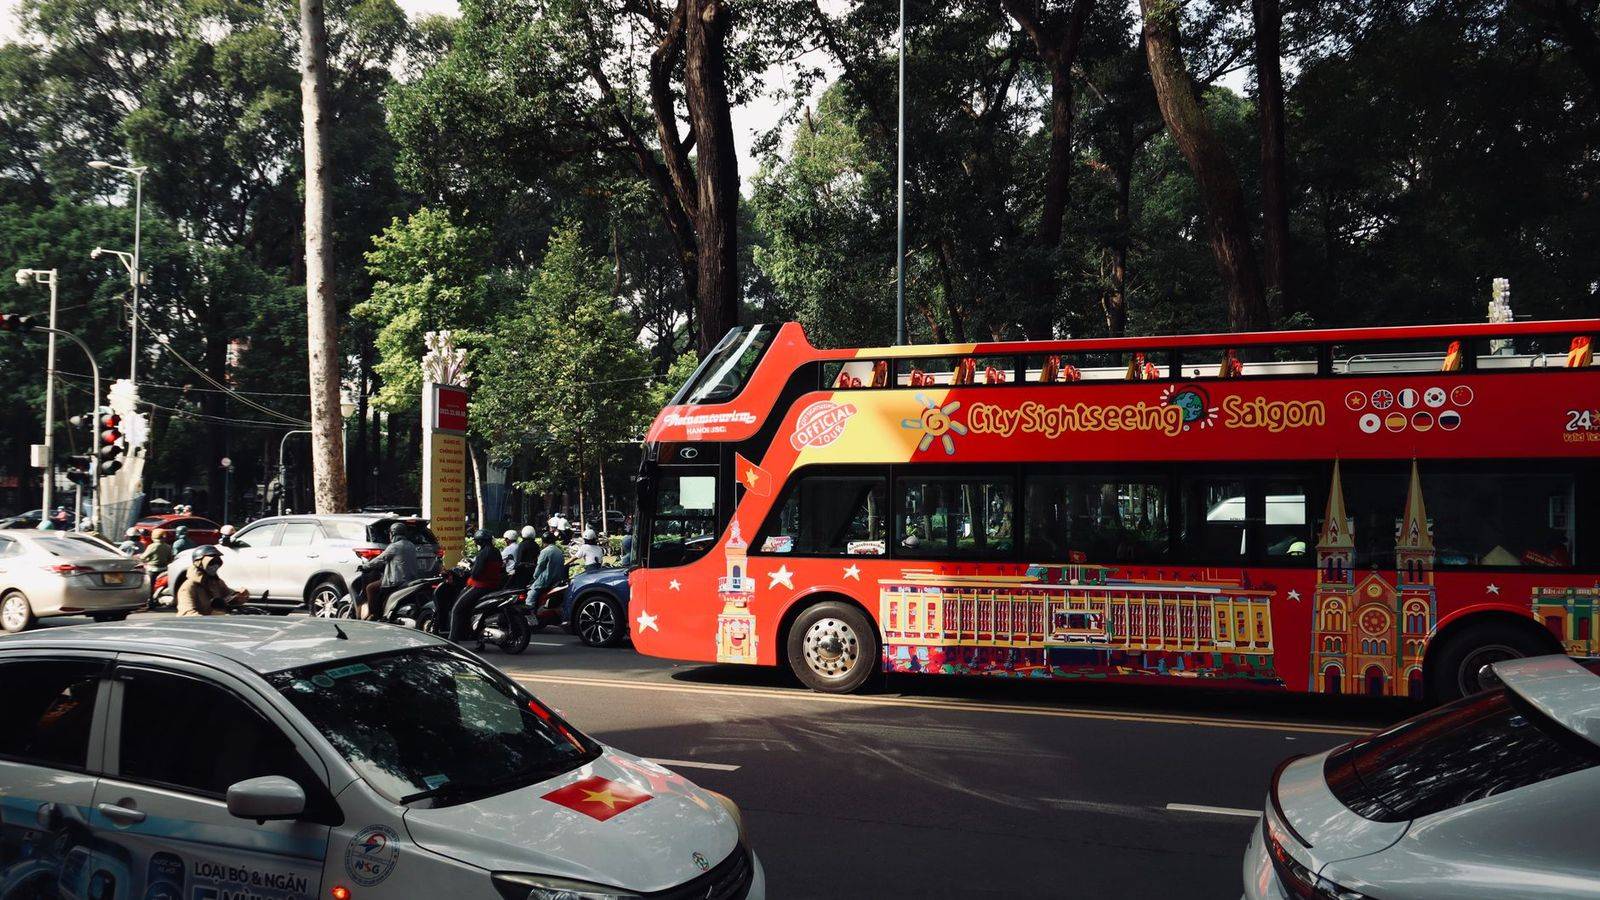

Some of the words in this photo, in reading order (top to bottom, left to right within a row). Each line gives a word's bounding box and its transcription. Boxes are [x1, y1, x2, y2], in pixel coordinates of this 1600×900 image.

[797, 405, 853, 444] OFFICIAL
[1223, 394, 1325, 432] Saigon
[818, 425, 843, 444] TOUR
[194, 862, 225, 883] LOẠI
[252, 871, 263, 885] &
[355, 860, 380, 874] NSG
